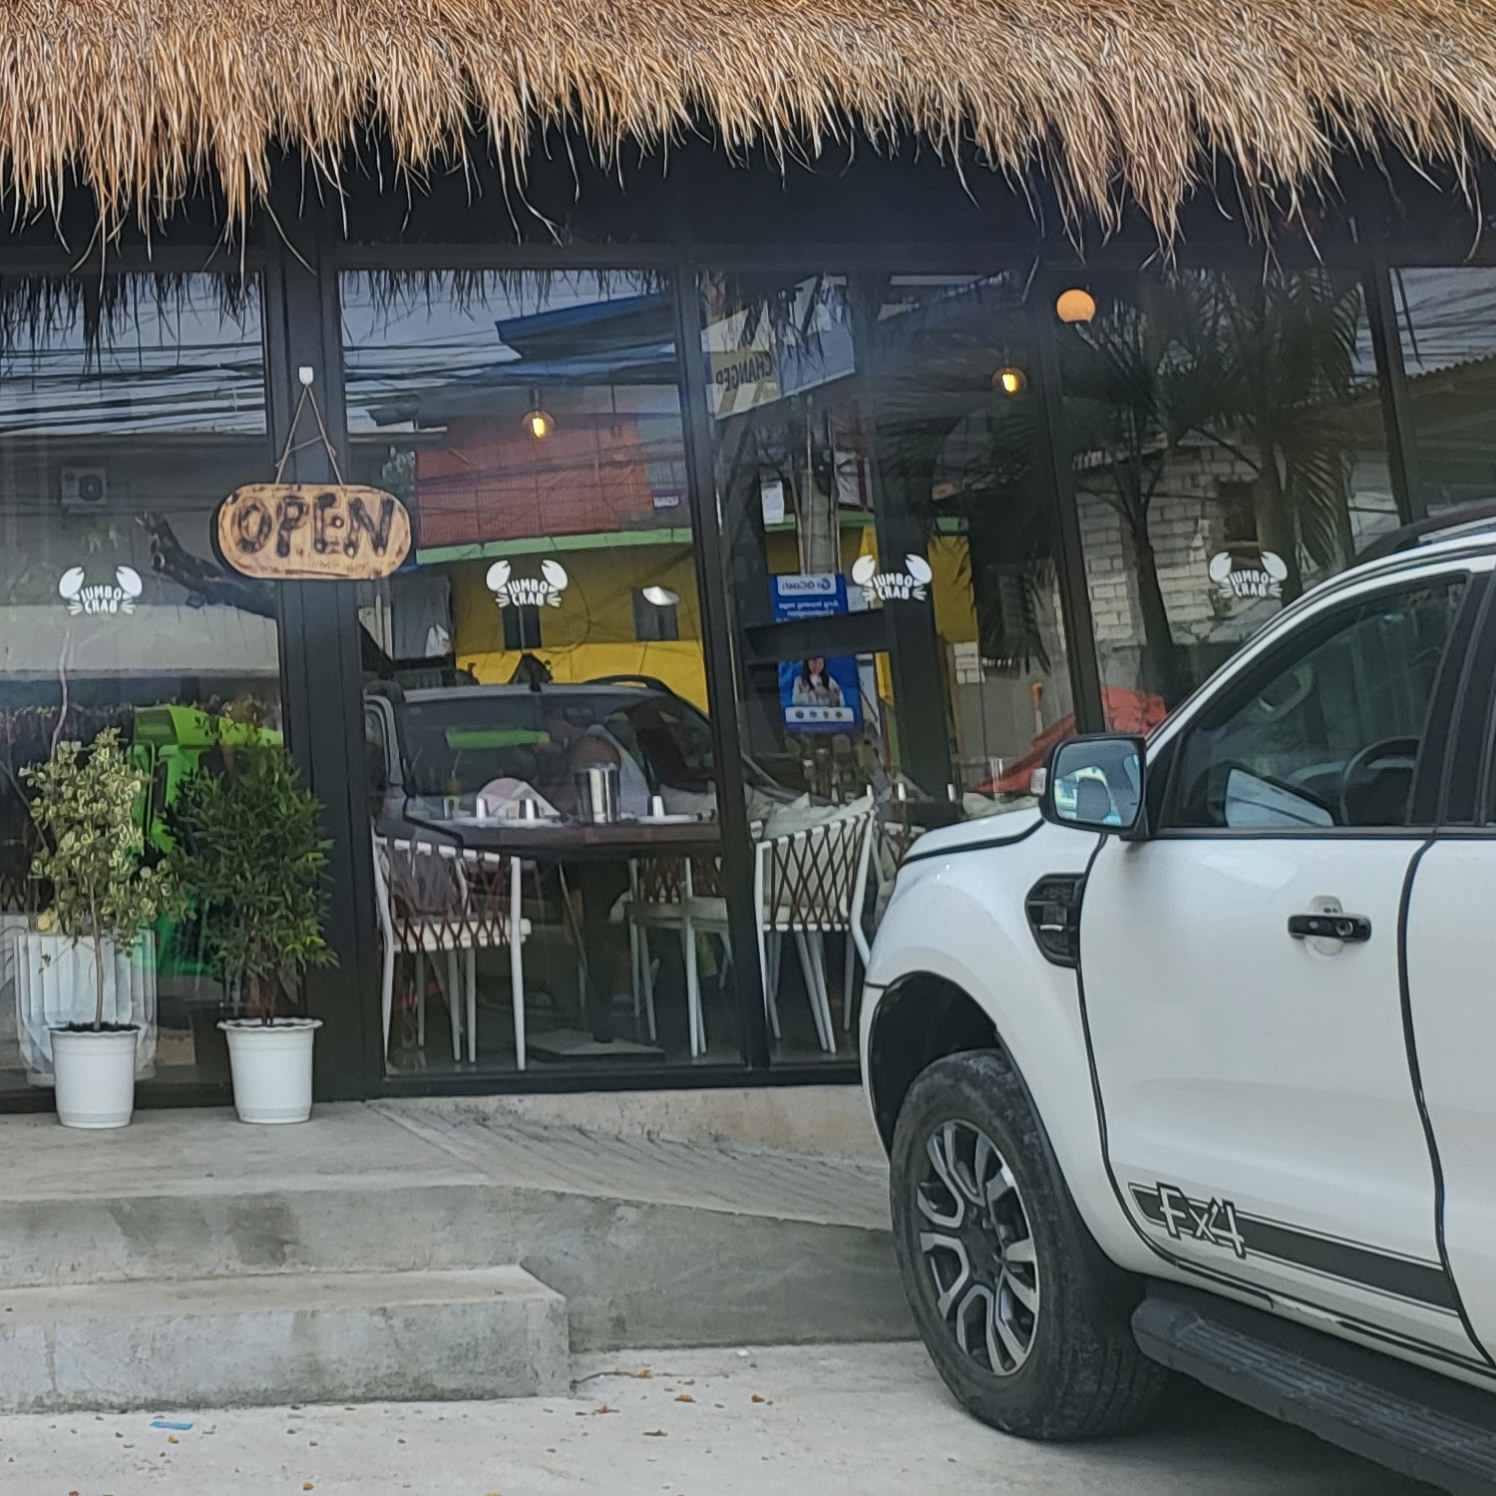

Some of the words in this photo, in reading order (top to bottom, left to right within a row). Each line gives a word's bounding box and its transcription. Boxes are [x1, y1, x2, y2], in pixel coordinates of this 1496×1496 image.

[235, 493, 396, 558] OPEN
[508, 578, 548, 594] JUMBO
[873, 572, 913, 589] JUMBO
[1229, 570, 1270, 586] JUMBO
[81, 585, 122, 602] JUMBO
[512, 592, 545, 607] CRAB
[878, 586, 910, 600] CRAB
[85, 599, 118, 614] CRAB
